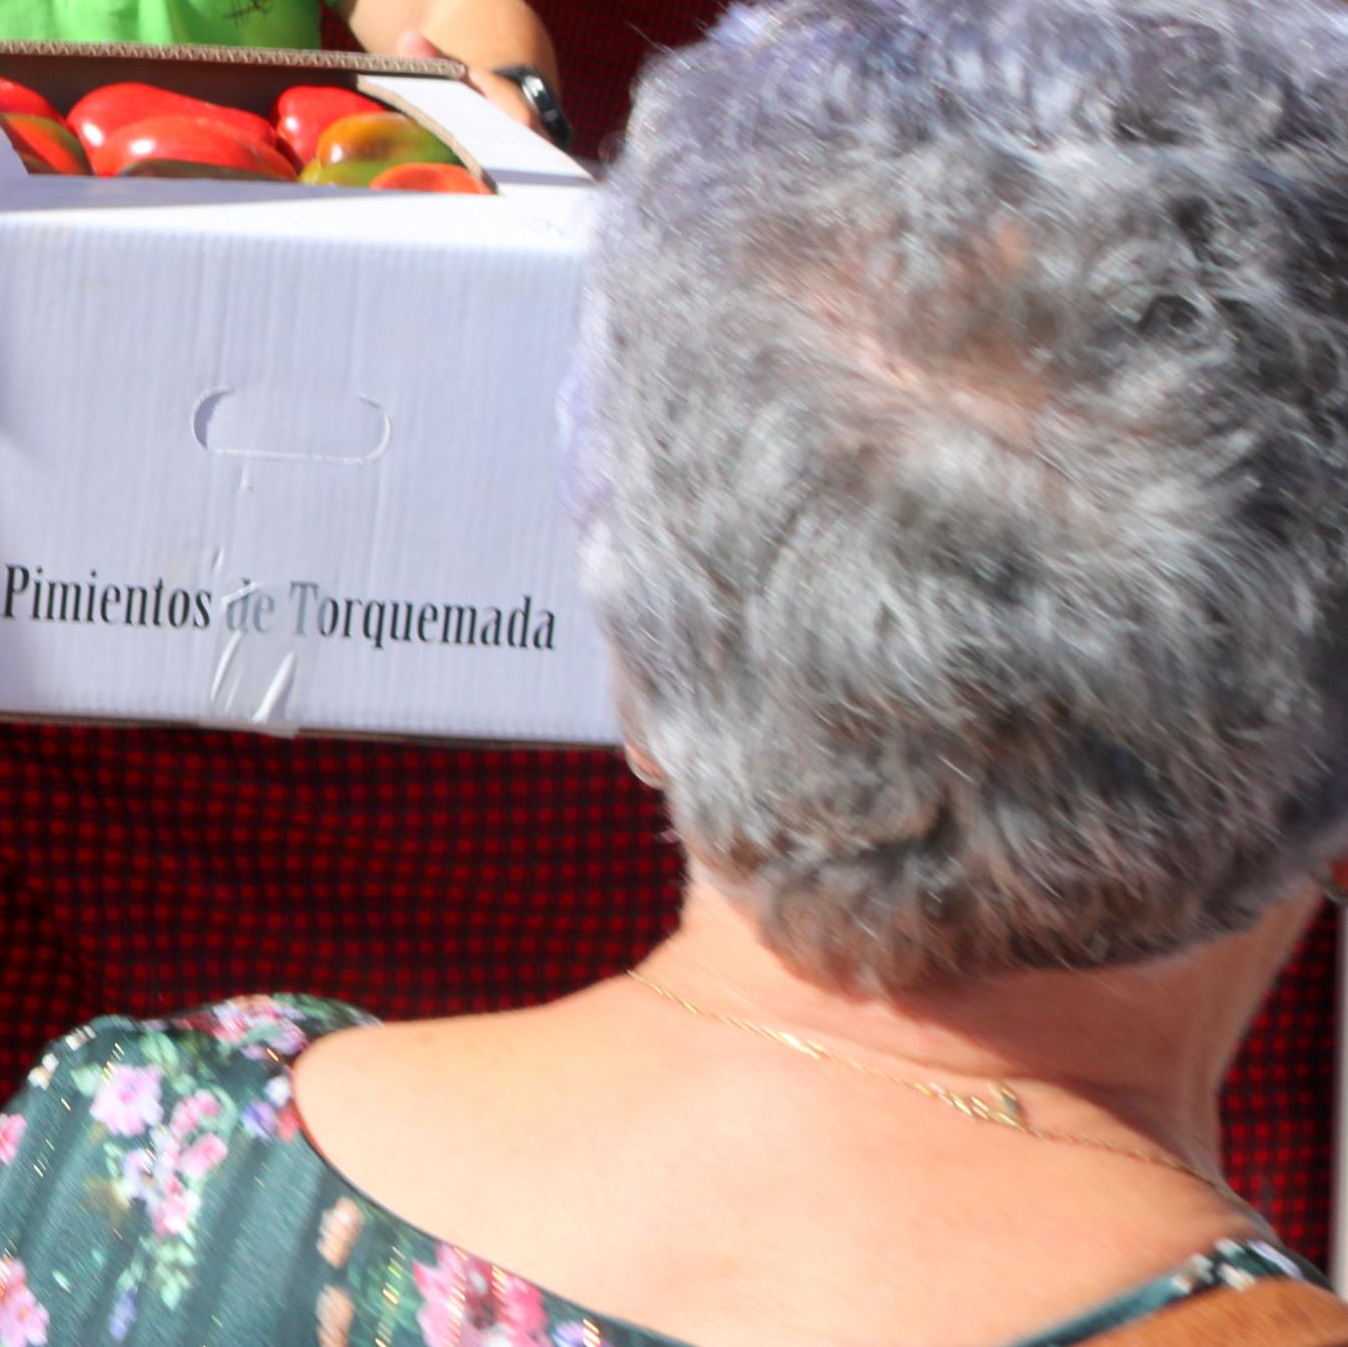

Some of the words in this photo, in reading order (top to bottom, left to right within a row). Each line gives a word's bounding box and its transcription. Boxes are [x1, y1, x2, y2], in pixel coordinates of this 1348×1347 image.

[2, 563, 212, 630] Pimientos
[226, 577, 275, 635] de
[288, 580, 556, 651] Torquemada
